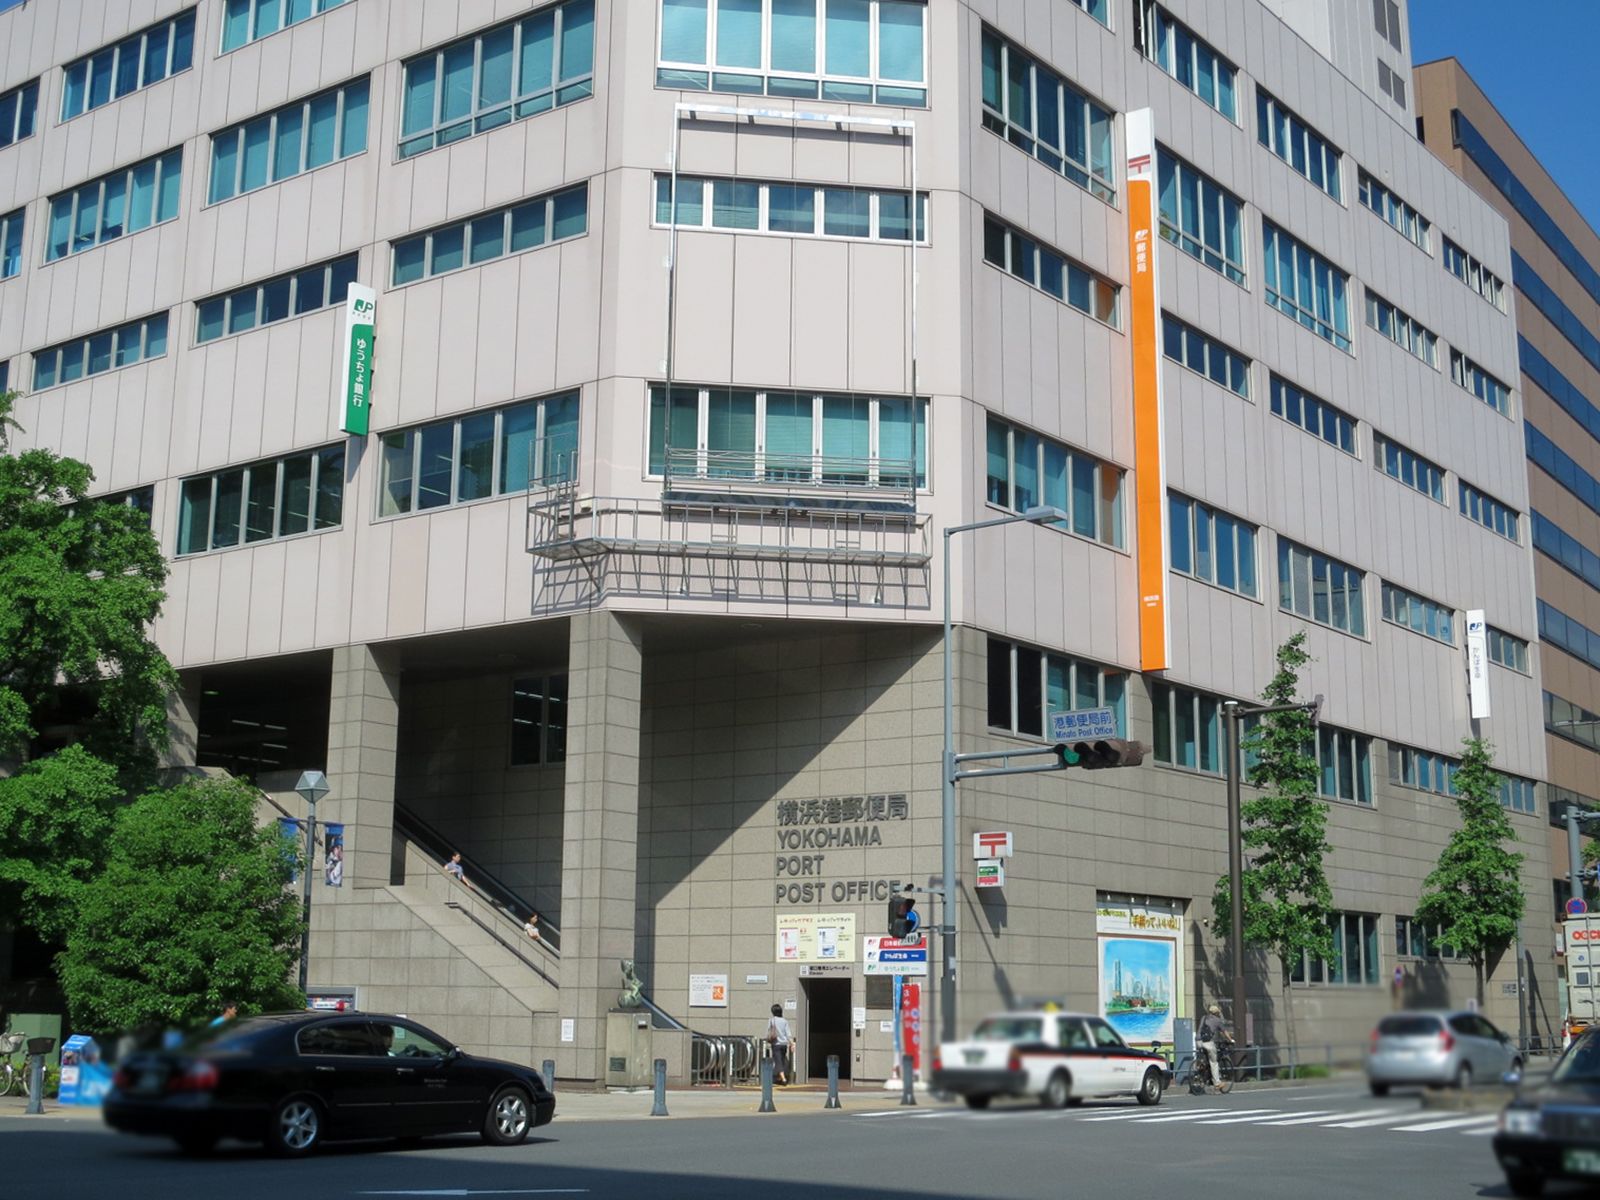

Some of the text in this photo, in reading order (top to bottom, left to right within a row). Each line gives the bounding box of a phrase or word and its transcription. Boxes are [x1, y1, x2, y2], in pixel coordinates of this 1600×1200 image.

[1055, 711, 1112, 729] 港郵便局前
[1055, 726, 1113, 738] Minato Post Office
[777, 794, 908, 826] 横浜港郵便局
[777, 826, 882, 849] YOKOHAMA
[776, 855, 825, 876] PORT
[776, 882, 826, 904] POST
